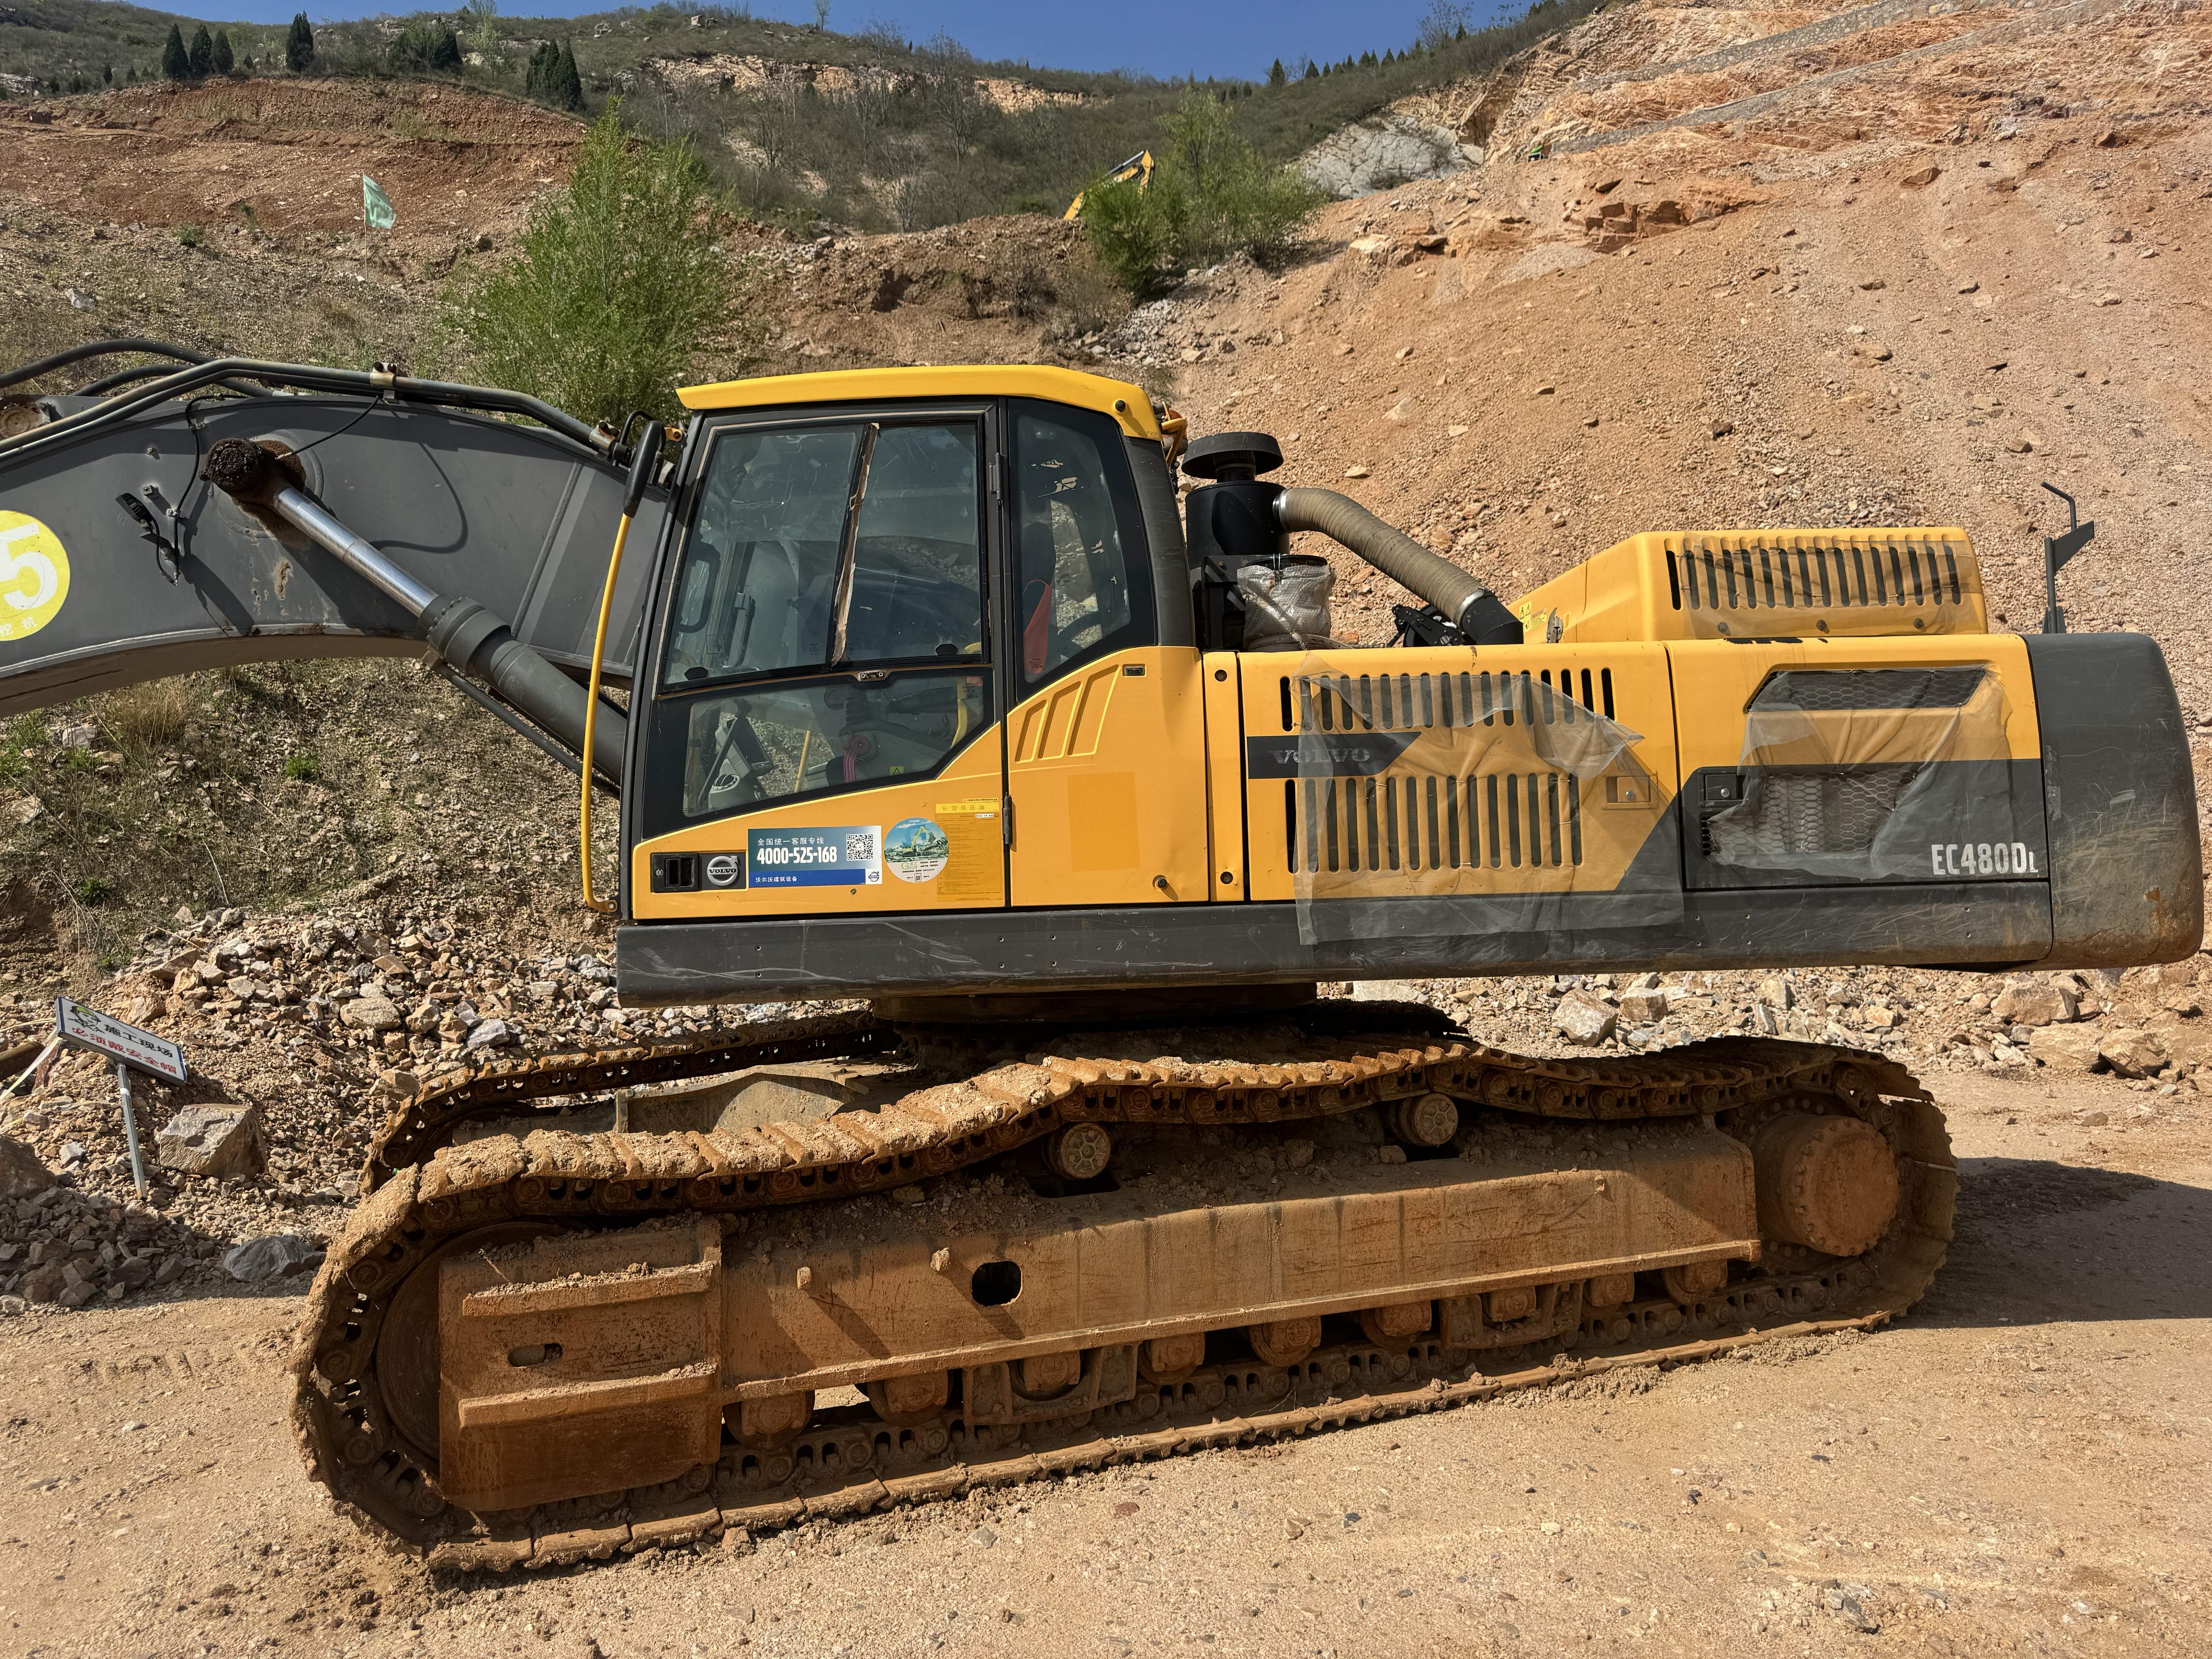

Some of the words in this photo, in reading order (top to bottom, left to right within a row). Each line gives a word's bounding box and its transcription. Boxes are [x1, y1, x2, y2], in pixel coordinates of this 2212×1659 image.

[0, 522, 57, 610] 5
[1269, 747, 1370, 764] VOLVO
[757, 836, 824, 846] 全国统一客服专线
[757, 846, 837, 865] 4000-525-168
[72, 1027, 177, 1074] 必须戴安全帽
[104, 1024, 173, 1058] 施工现场
